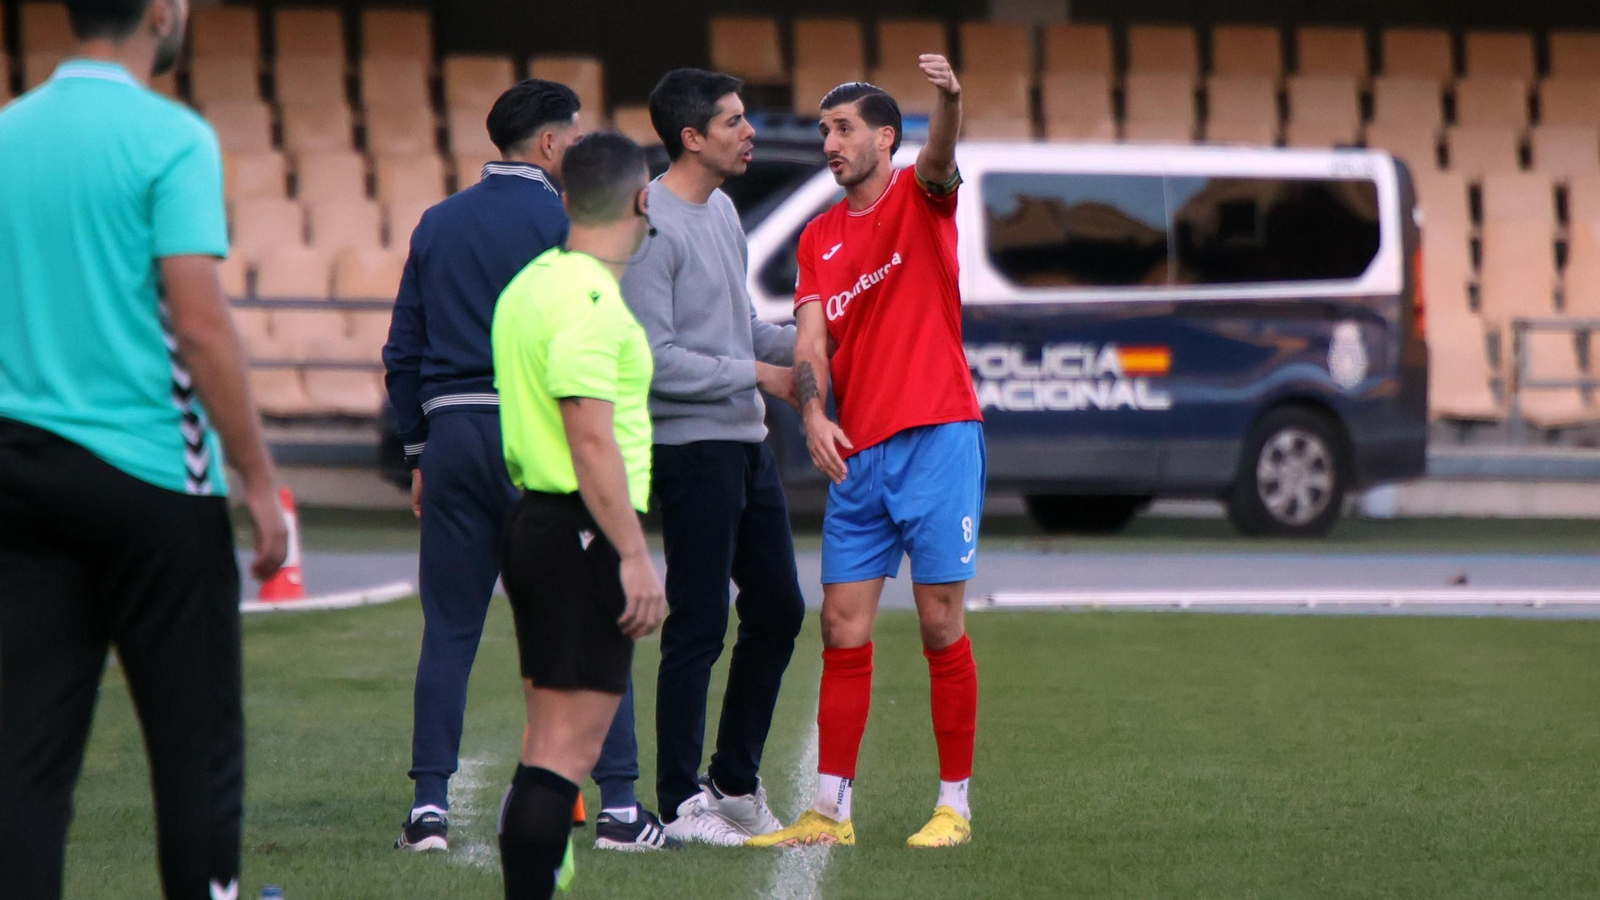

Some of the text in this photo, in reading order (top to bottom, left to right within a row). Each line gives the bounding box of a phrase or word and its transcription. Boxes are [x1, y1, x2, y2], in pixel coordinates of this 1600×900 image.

[974, 380, 1171, 411] ACIONAL
[961, 516, 973, 543] 8
[836, 778, 848, 805] ESION
